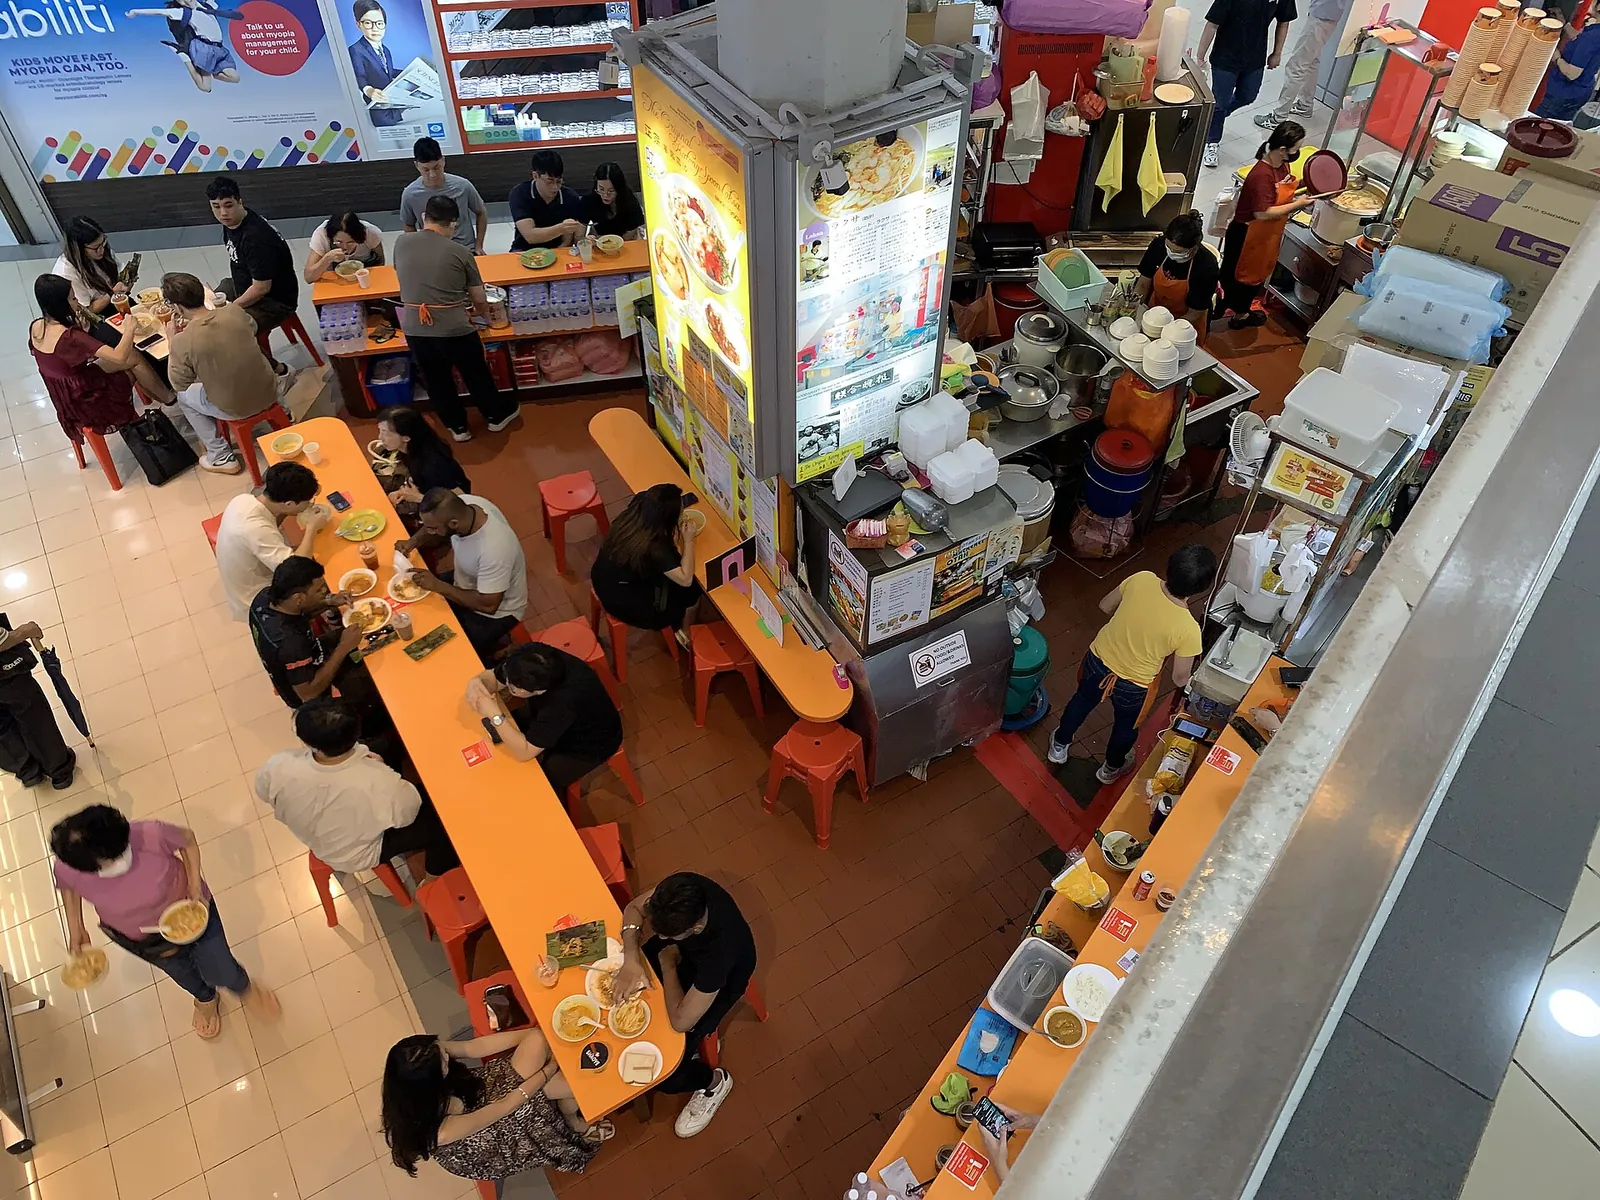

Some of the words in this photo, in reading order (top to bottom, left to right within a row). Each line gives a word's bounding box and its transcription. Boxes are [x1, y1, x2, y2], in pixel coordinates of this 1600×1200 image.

[266, 30, 296, 38] myopia
[245, 39, 296, 48] management
[259, 48, 277, 56] your
[10, 57, 41, 67] KIDS
[43, 55, 79, 65] MOVE
[81, 52, 118, 62] FAST.
[8, 65, 61, 77] MYOPIA
[64, 63, 96, 73] CAN,
[97, 61, 128, 71] TOO.
[642, 92, 660, 117] The
[1438, 185, 1480, 212] A500
[1541, 210, 1581, 226] DRINKING
[805, 230, 824, 240] Laksa
[940, 640, 956, 650] OUTSIDE
[937, 655, 954, 665] ALLOWED
